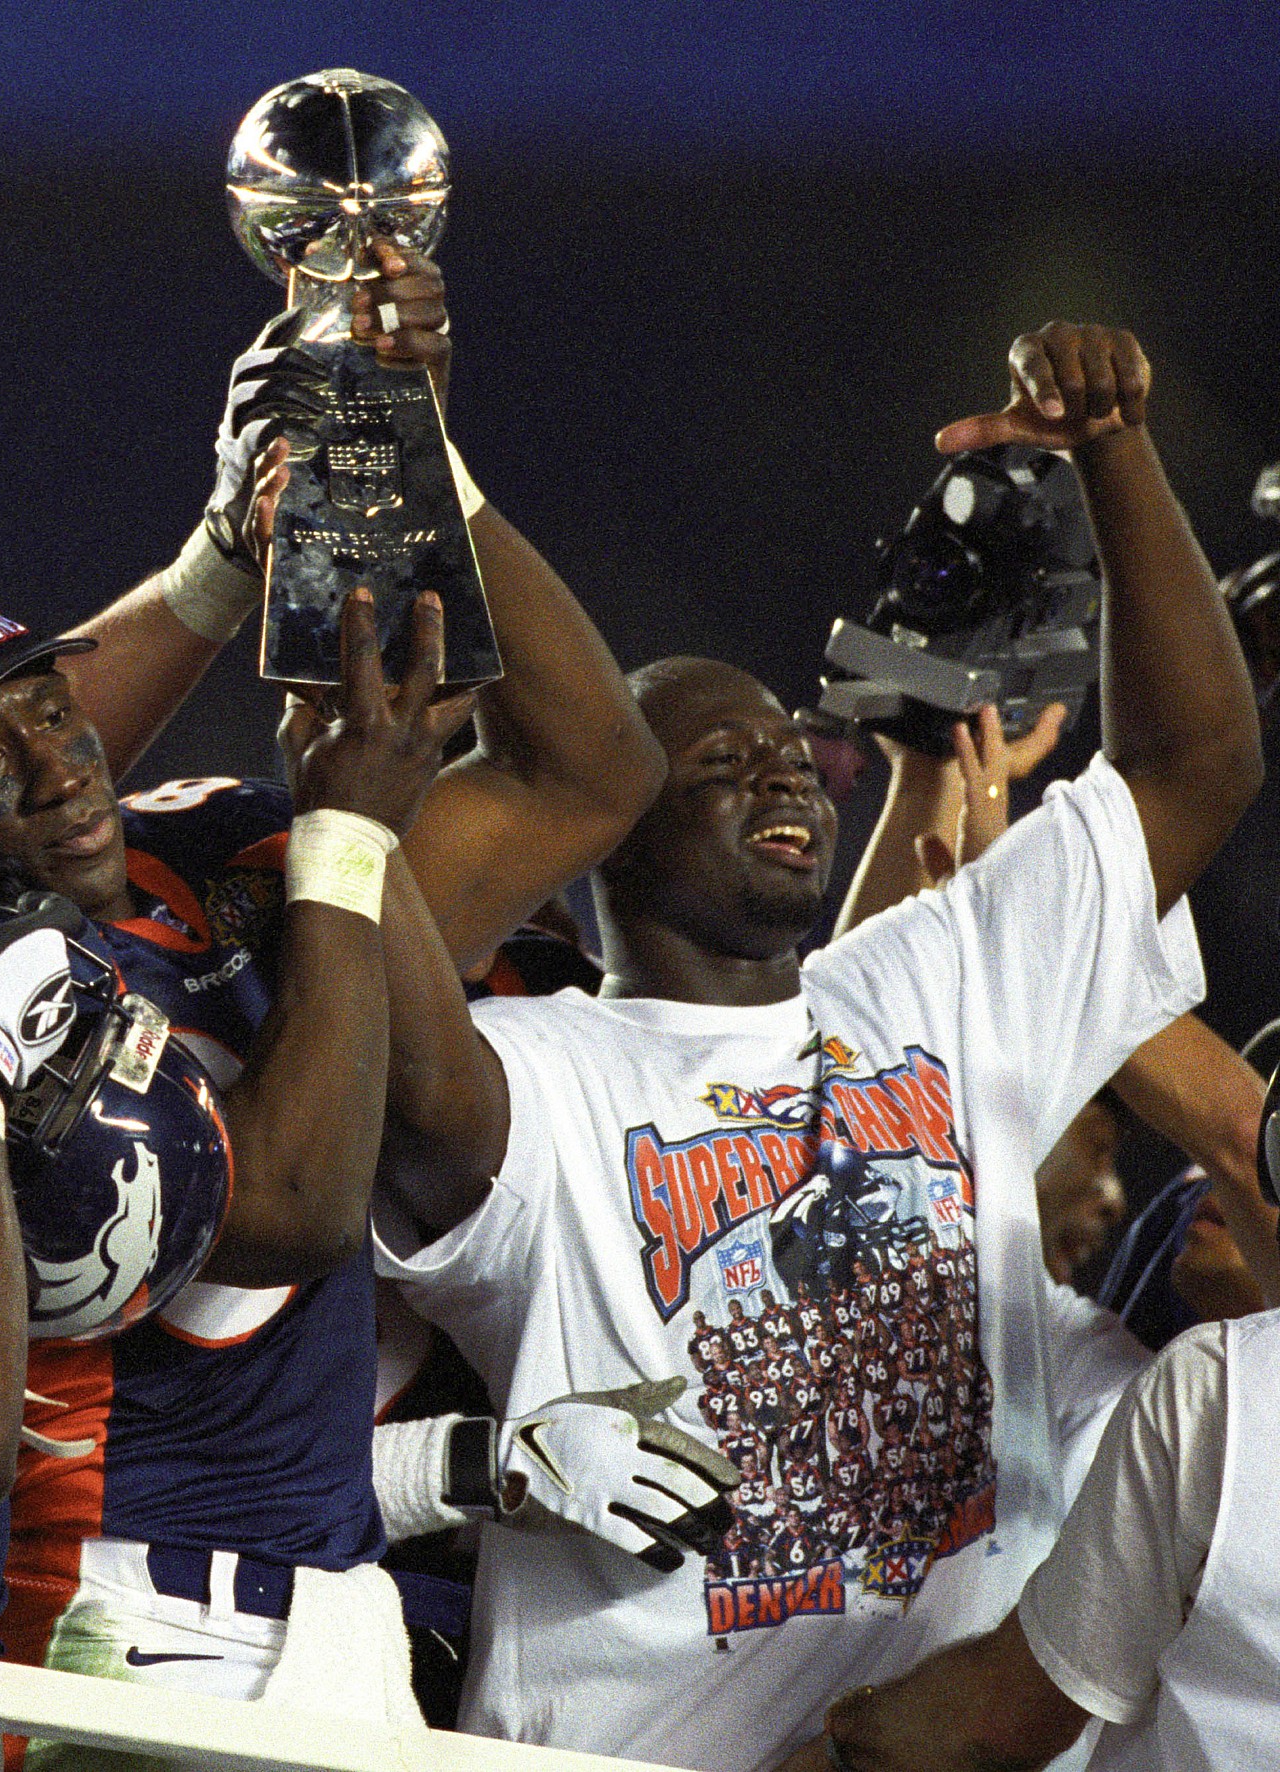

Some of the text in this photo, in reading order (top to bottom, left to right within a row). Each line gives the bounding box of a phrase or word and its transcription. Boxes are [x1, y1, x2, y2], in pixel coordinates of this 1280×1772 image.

[632, 1130, 776, 1308] SUPER
[725, 1260, 762, 1289] NFL
[800, 1308, 822, 1331] 85
[835, 1301, 862, 1324] 86
[730, 1326, 759, 1352] 83
[766, 1358, 795, 1381] 66
[709, 1393, 739, 1416] 92
[749, 1387, 779, 1410] 93
[834, 1408, 859, 1431] 78
[790, 1475, 816, 1497] 56
[838, 1463, 860, 1487] 57
[739, 1480, 766, 1501] 53
[789, 1539, 805, 1564] 6
[707, 1560, 844, 1635] DENVER
